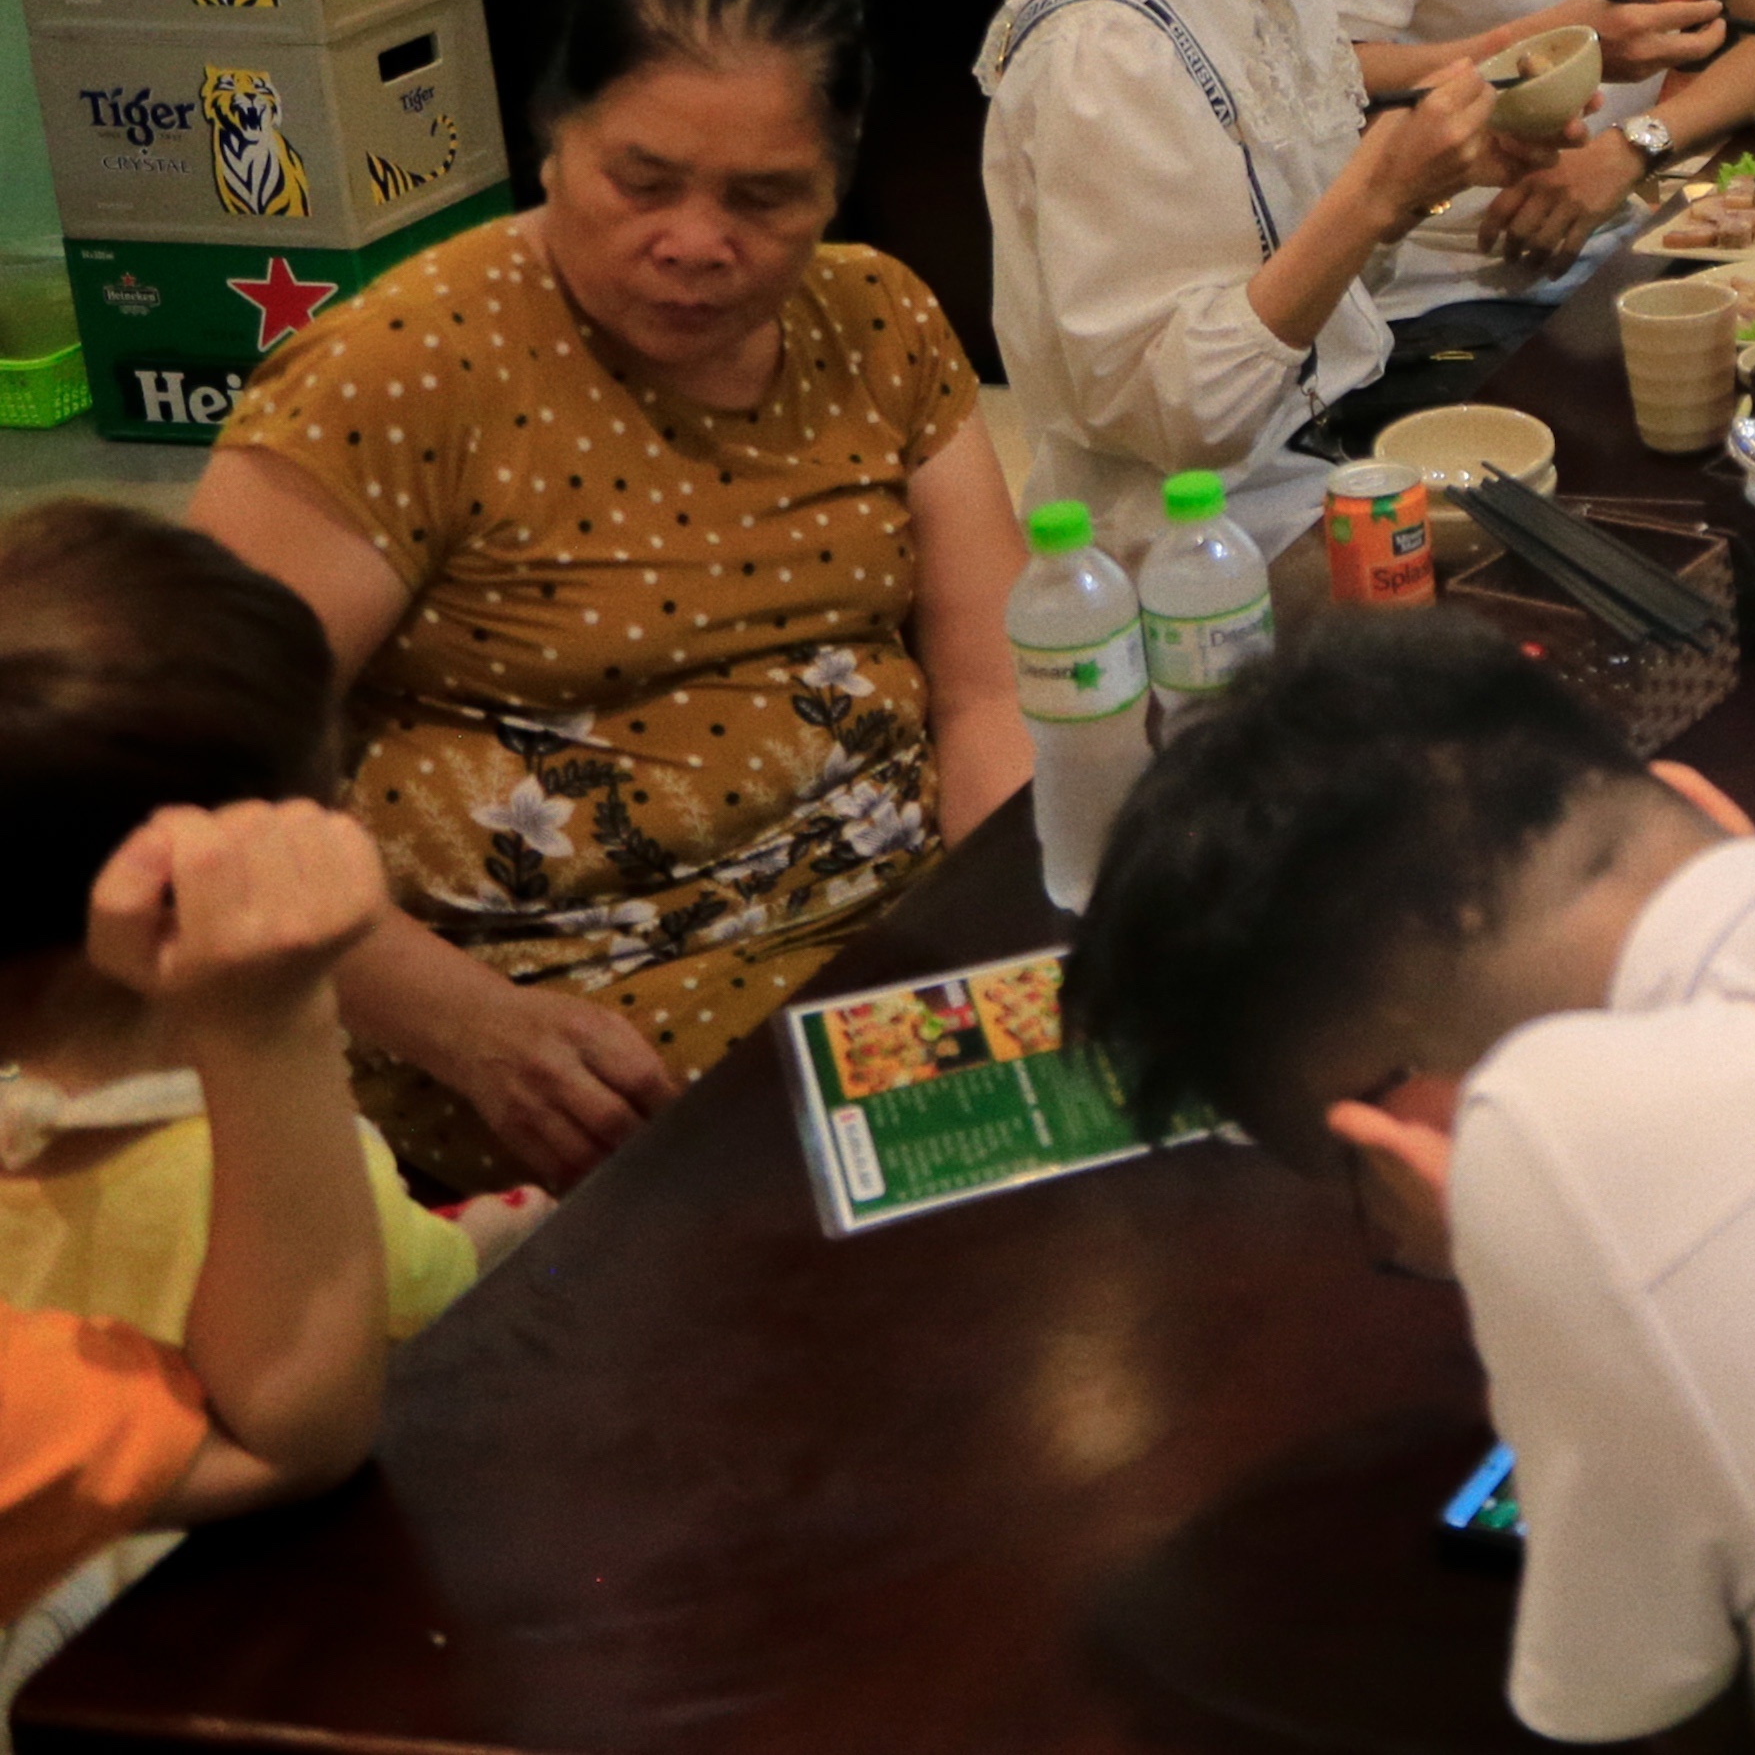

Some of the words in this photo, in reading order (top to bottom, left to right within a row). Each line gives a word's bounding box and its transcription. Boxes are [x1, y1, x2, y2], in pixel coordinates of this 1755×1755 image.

[400, 85, 436, 111] Tiger
[80, 87, 195, 146] Tiger
[102, 155, 193, 175] CRYSTAL
